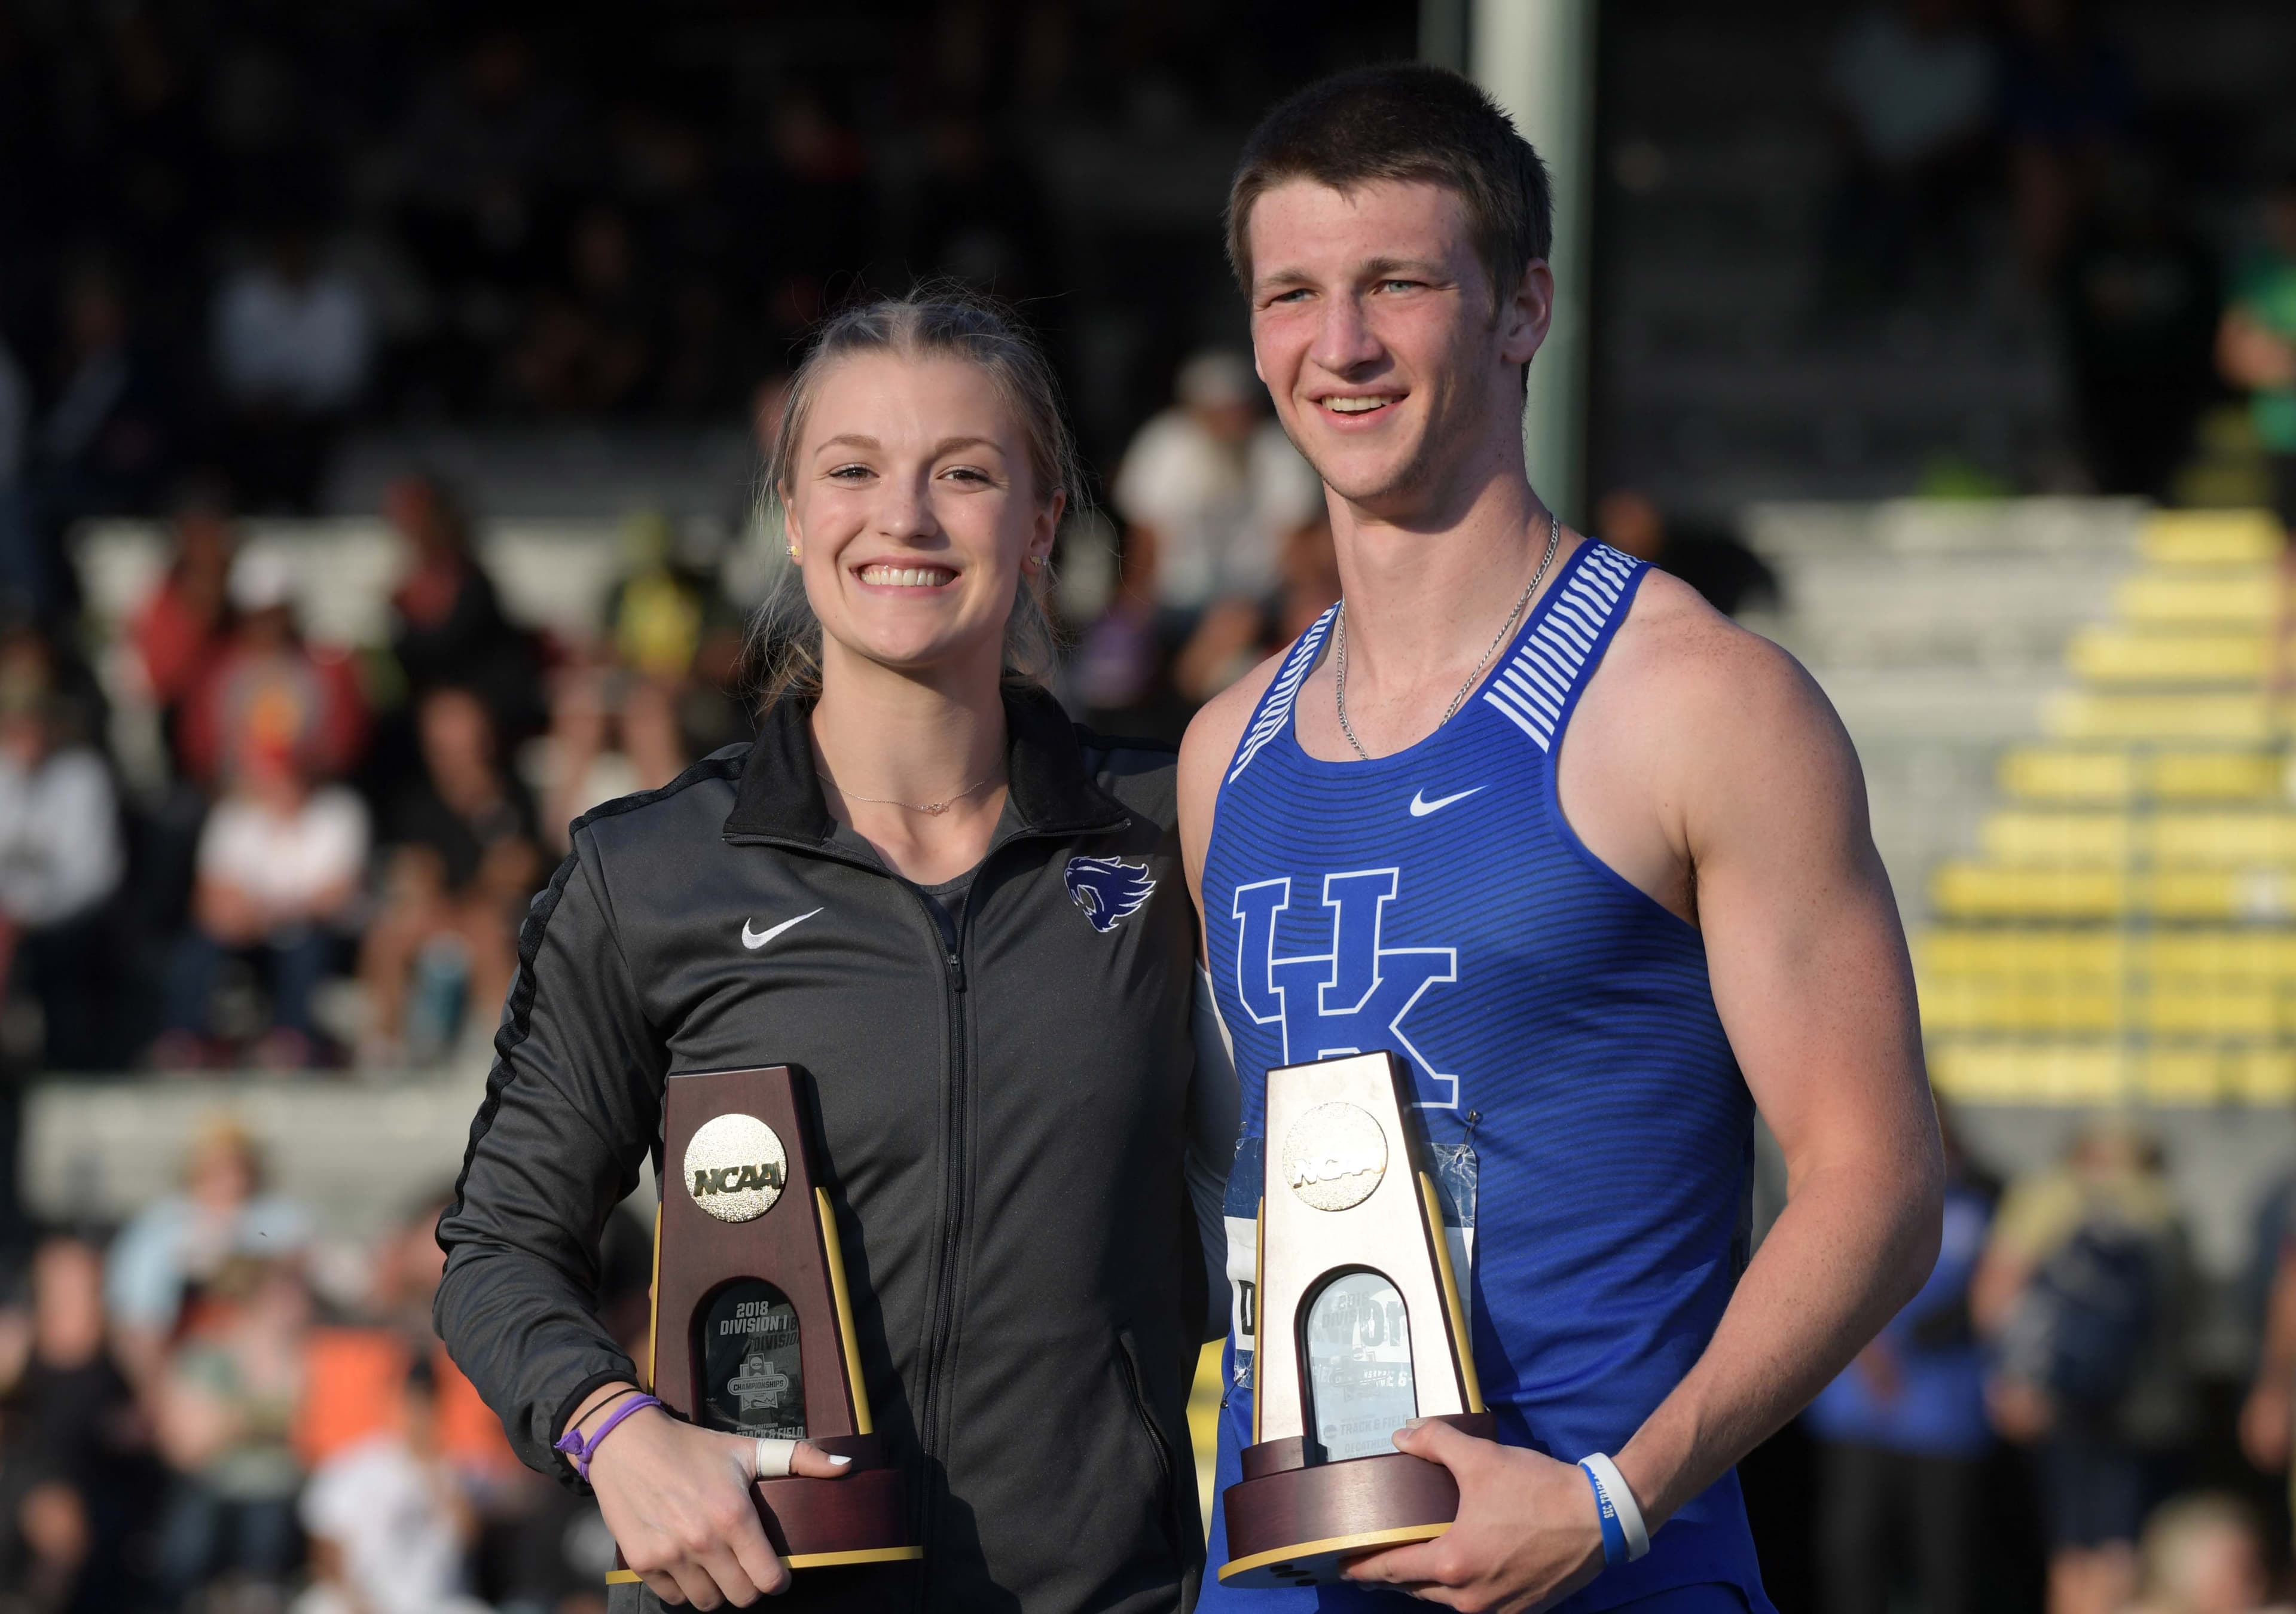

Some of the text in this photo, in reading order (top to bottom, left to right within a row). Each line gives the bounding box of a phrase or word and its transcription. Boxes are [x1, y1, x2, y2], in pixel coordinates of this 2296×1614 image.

[1232, 867, 1458, 1109] UK
[693, 1161, 783, 1197] NCAA
[736, 1300, 769, 1318] 2018
[719, 1315, 788, 1336] DIVISION I
[733, 1380, 784, 1392] CHAMPIONSHIPS
[736, 1429, 768, 1439] RACK
[777, 1426, 804, 1439] FIELD
[1602, 1504, 1614, 1519] SEC
